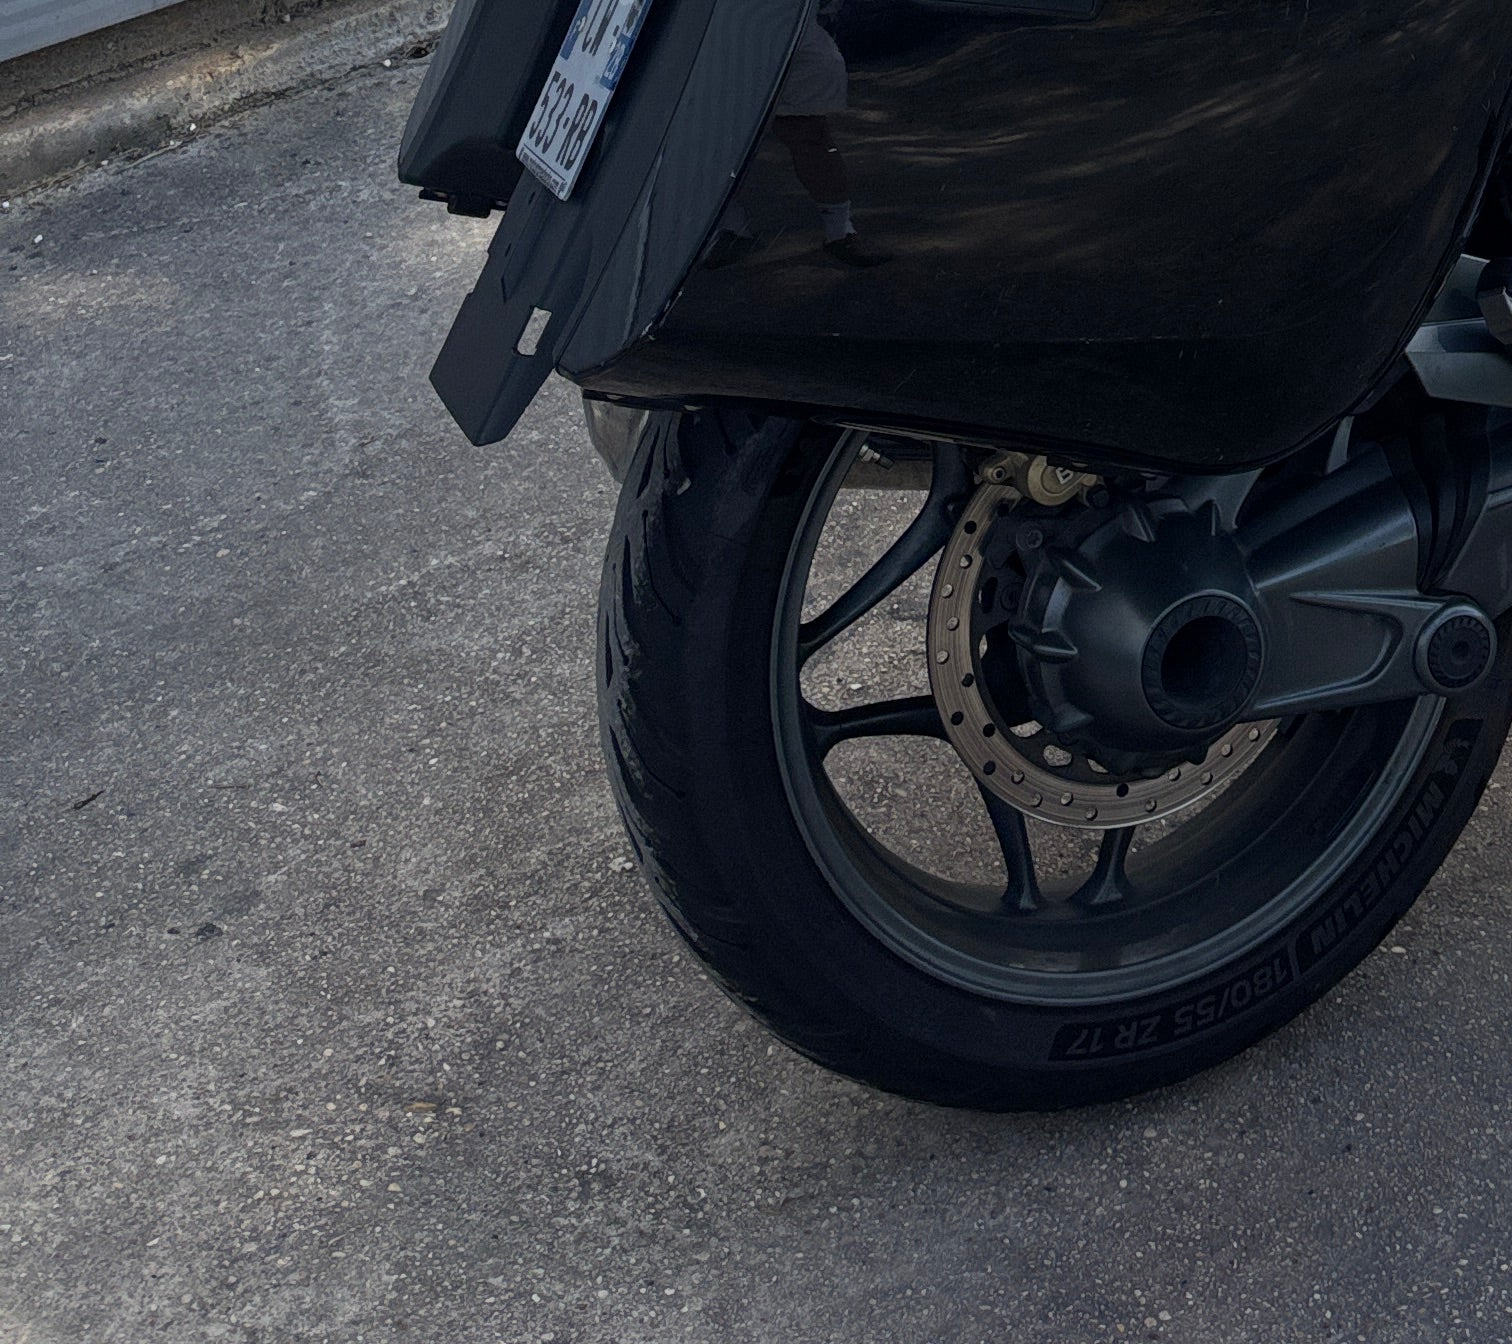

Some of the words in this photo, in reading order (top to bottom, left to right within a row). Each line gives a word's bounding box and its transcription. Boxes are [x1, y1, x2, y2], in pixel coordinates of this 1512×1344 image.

[1311, 780, 1447, 955] MICHELIN
[1173, 954, 1288, 1037] 180/55
[1067, 1025, 1104, 1056] 17
[1115, 1015, 1164, 1049] ZR
